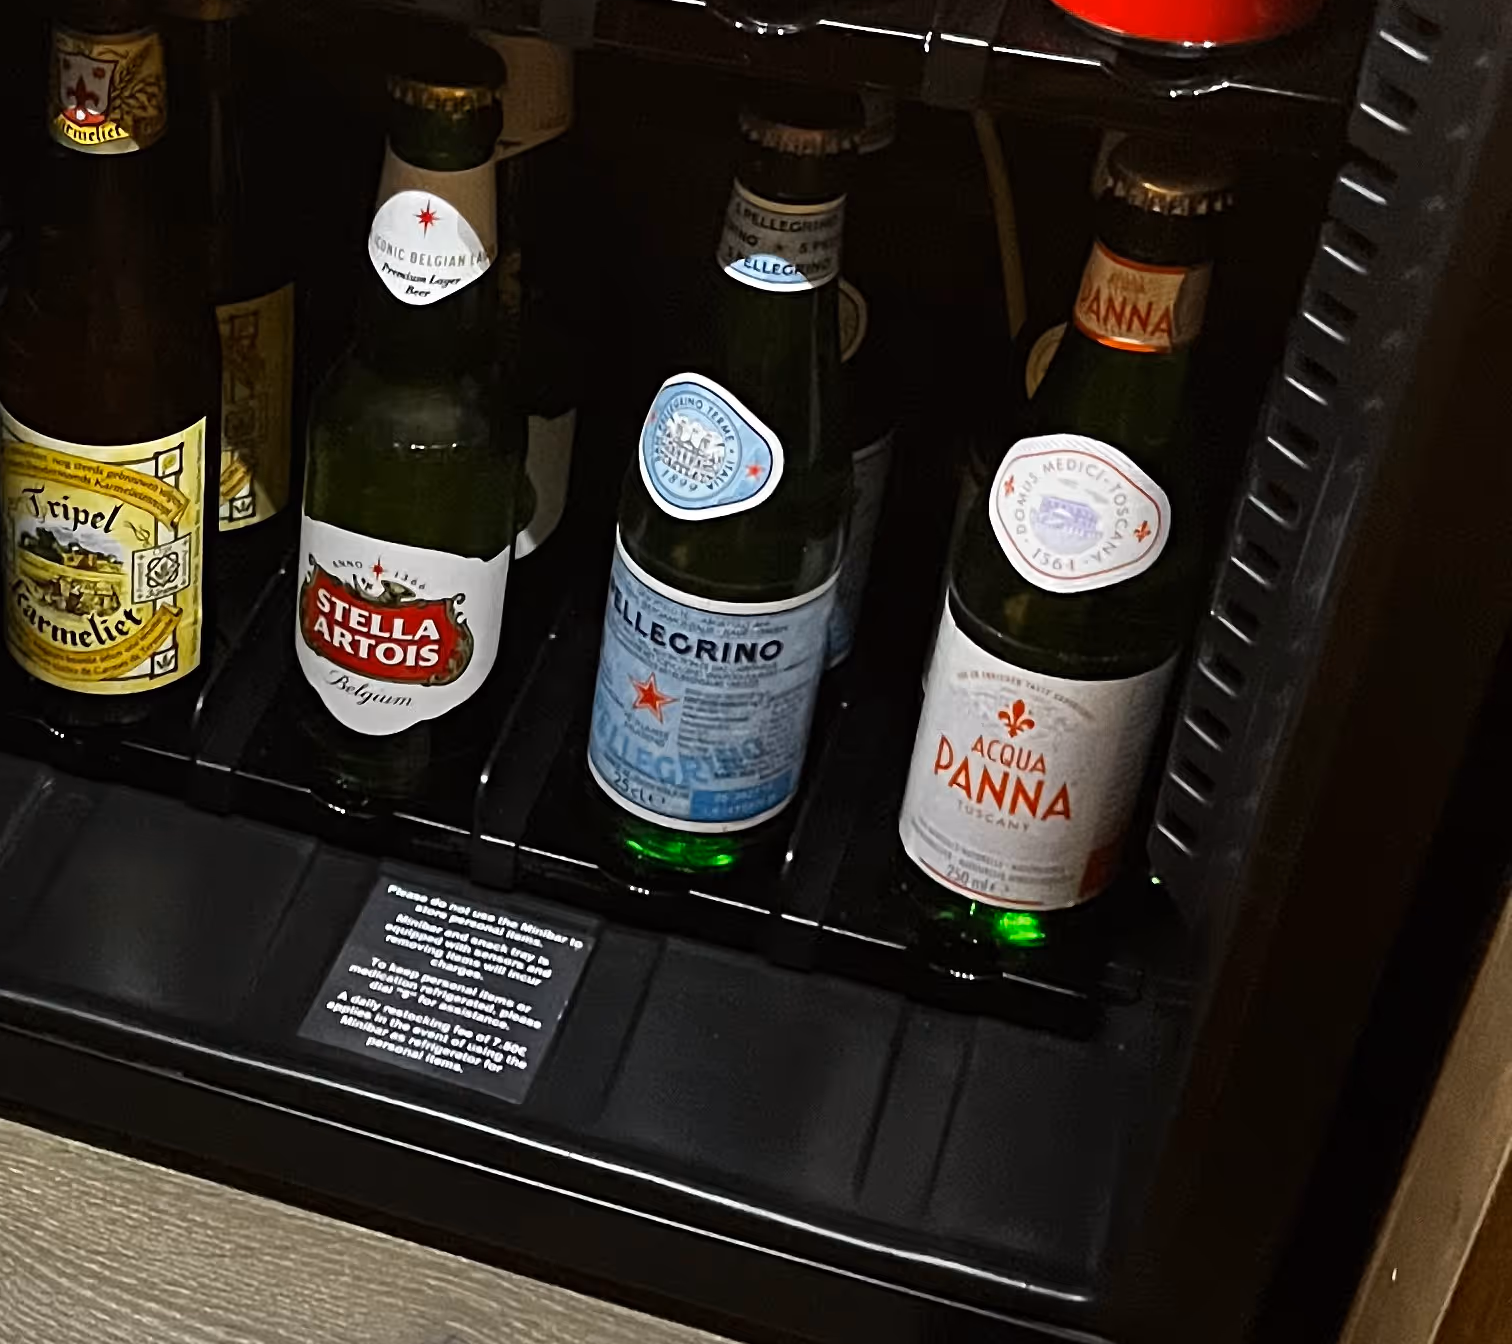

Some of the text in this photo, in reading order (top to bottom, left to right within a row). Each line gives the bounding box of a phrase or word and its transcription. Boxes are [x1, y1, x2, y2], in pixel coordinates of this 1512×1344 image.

[381, 262, 462, 289] Premium Lager
[405, 284, 432, 298] Beer
[707, 406, 735, 442] TERME
[20, 484, 125, 535] Tripel
[1014, 457, 1130, 564] DOMUS MEDICI TOSCANA
[316, 587, 441, 641] STELLA
[314, 614, 440, 668] ARTOIS
[324, 669, 413, 708] Belgium
[934, 733, 1072, 822] PANNA
[971, 733, 1047, 776] ACQUA
[957, 799, 1031, 833] TUSCANY
[945, 863, 970, 888] 250
[388, 884, 583, 949] Please do not use the Minibar to
[395, 913, 550, 967] Minibar and snack tray is
[414, 904, 448, 920] store
[448, 914, 505, 937] personal
[384, 923, 552, 979] equipped with sensors and
[385, 934, 543, 987] removing items will incur
[348, 963, 418, 991] medication
[498, 1008, 542, 1029] please
[368, 980, 394, 995] dial
[417, 994, 438, 1007] for
[371, 956, 533, 1014] To keep personal items or
[326, 1000, 528, 1070] applies in the event of using the
[336, 990, 348, 1002] A
[349, 994, 382, 1012] daily
[382, 1004, 452, 1034] restocking
[452, 1024, 474, 1039] fee
[475, 1033, 492, 1045] of
[339, 1014, 504, 1073] Minibar as refrigerator for
[365, 1036, 425, 1061] personal
